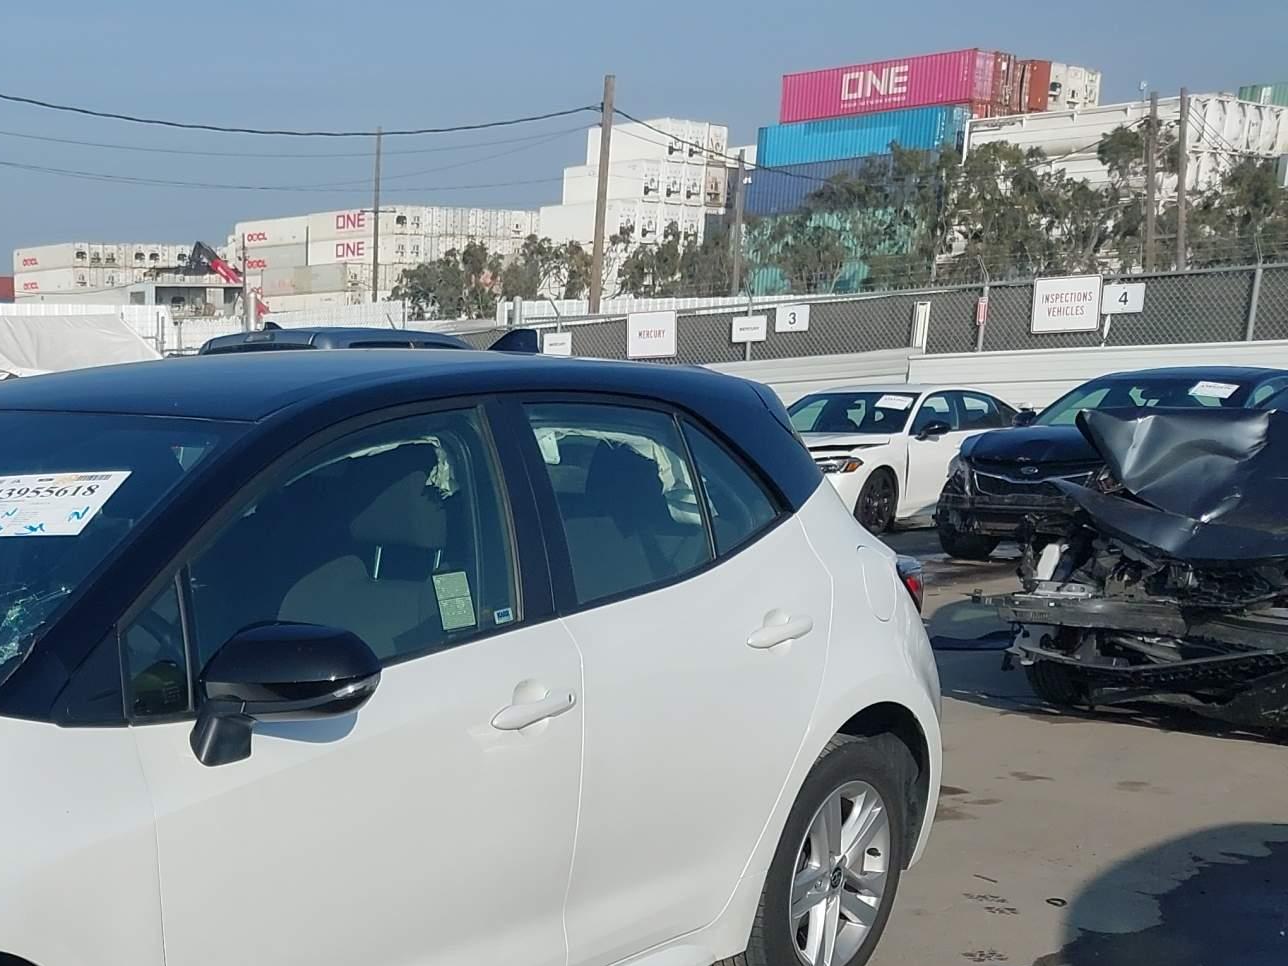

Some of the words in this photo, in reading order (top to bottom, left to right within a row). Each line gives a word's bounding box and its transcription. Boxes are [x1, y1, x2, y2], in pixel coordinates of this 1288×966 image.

[841, 65, 909, 101] ONE
[336, 213, 365, 229] ONE
[336, 242, 365, 258] ONE
[1041, 291, 1093, 305] INSPECTIONS
[1118, 291, 1129, 306] 4
[788, 311, 797, 325] 3
[1047, 305, 1085, 318] VEHICLES
[638, 329, 665, 339] MERCURY
